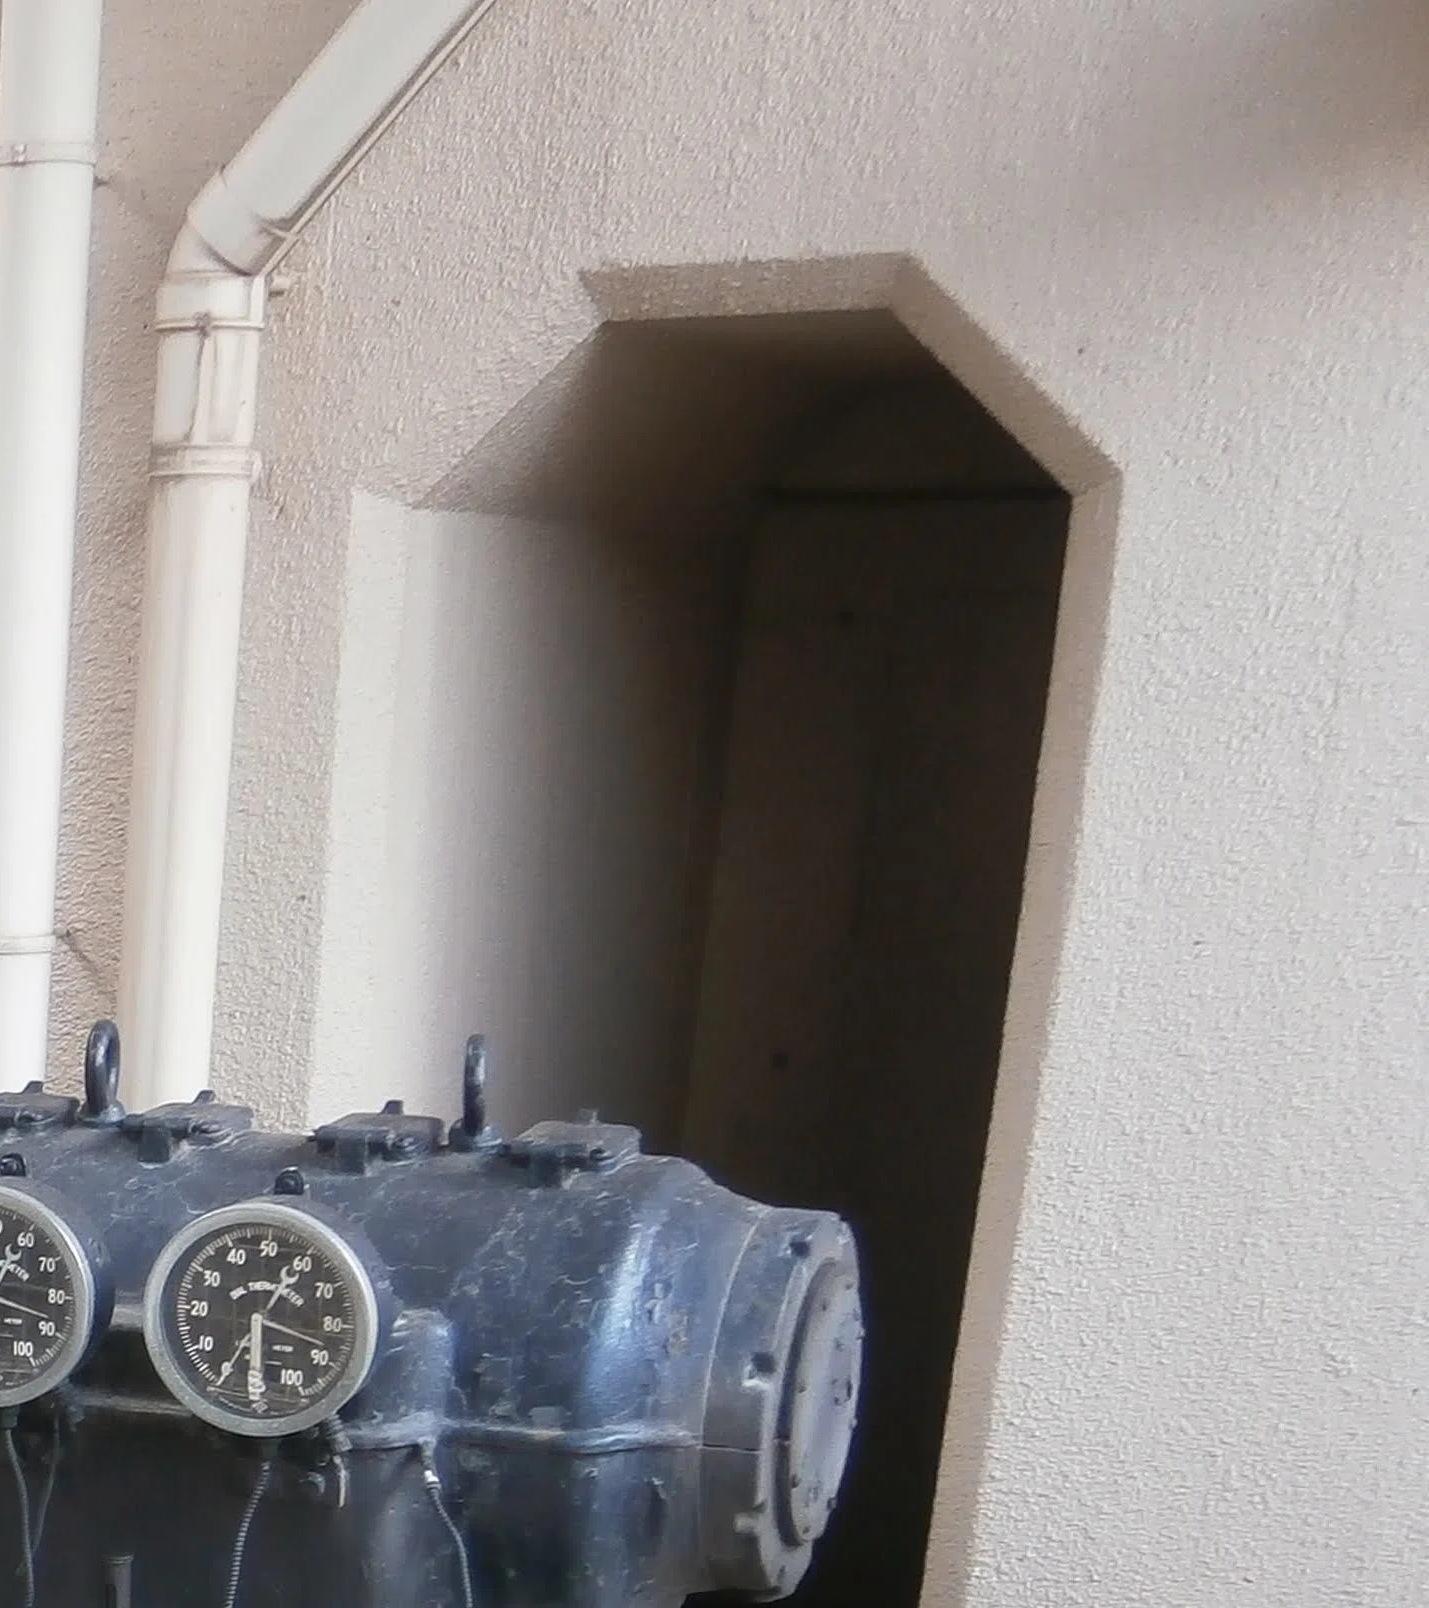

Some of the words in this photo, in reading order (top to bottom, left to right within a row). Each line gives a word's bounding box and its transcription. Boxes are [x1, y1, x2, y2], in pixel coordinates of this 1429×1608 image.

[17, 1232, 34, 1247] 60
[227, 1248, 246, 1265] 40
[260, 1240, 278, 1257] 50
[38, 1257, 55, 1272] 70
[293, 1256, 312, 1272] 60
[203, 1270, 221, 1287] 30
[48, 1289, 65, 1304] 80
[315, 1282, 334, 1298] 70
[191, 1300, 208, 1316] 20
[38, 1321, 55, 1336] 90
[323, 1316, 342, 1332] 80
[13, 1341, 33, 1357] 100
[198, 1335, 214, 1351] 10
[310, 1350, 329, 1366] 90
[280, 1369, 303, 1385] 100
